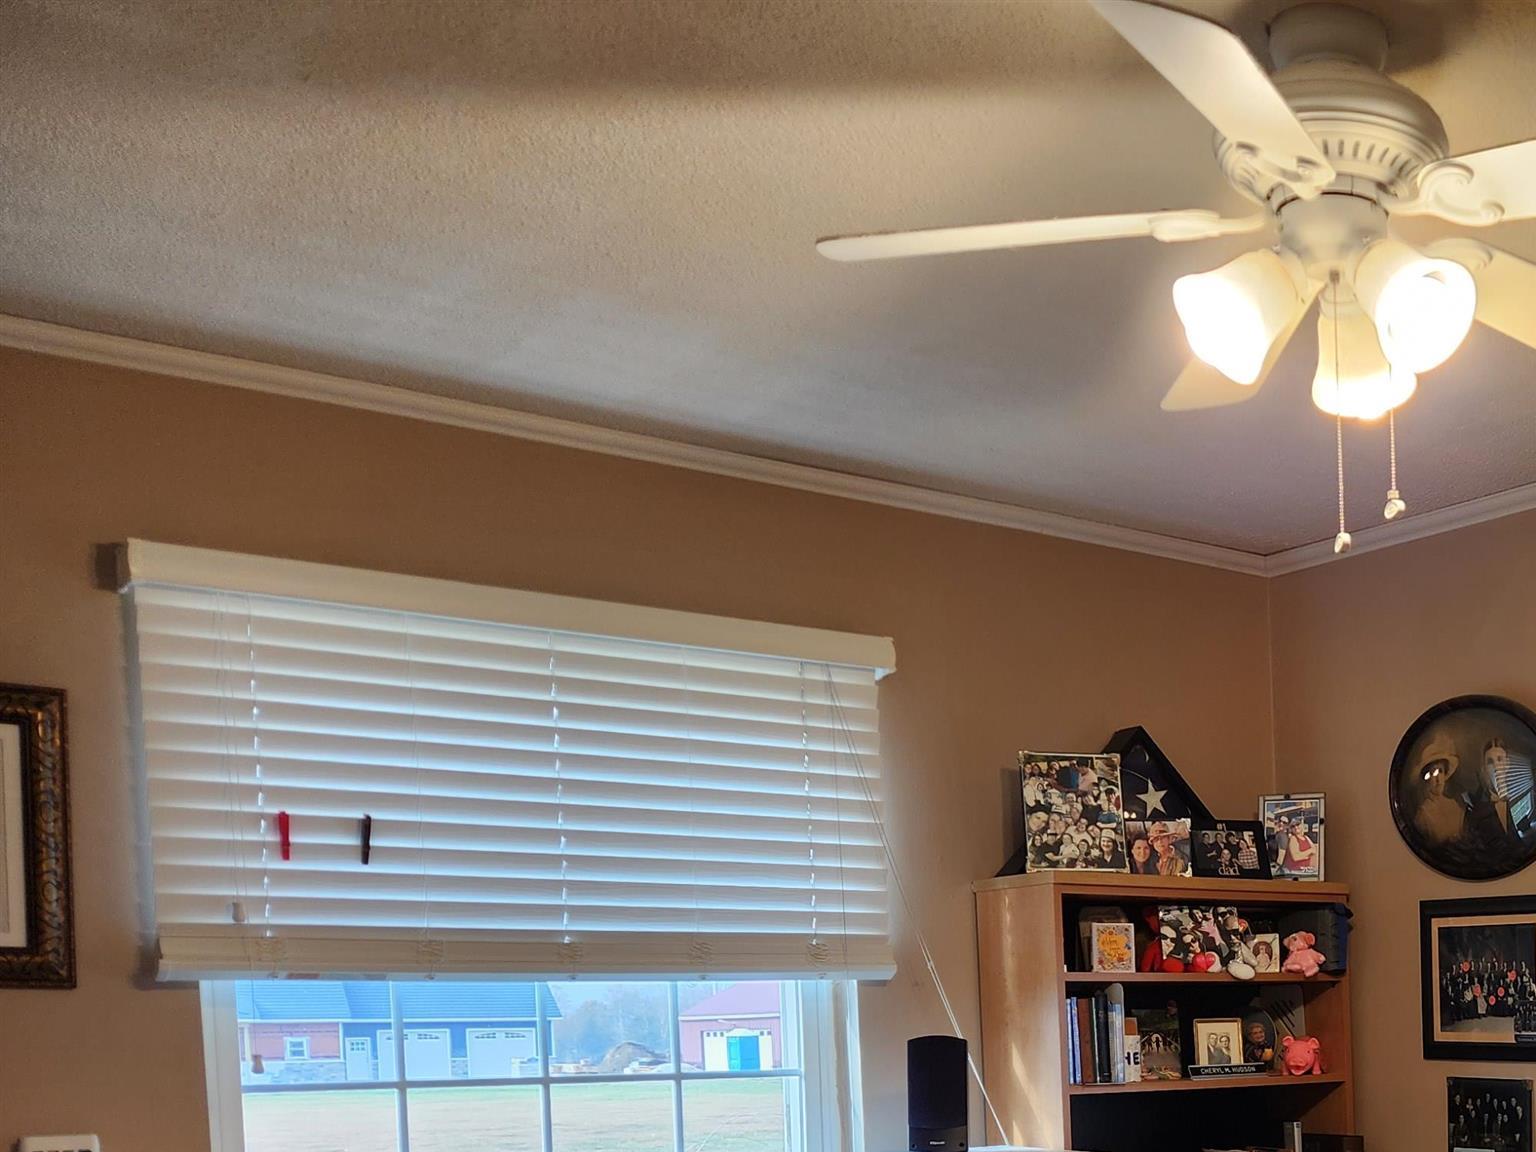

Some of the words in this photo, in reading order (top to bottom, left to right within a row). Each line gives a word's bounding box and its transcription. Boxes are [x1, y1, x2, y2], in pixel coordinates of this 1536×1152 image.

[1218, 864, 1240, 876] dad
[1200, 1066, 1223, 1075] CHERYL
[1232, 1065, 1256, 1073] HUDSON
